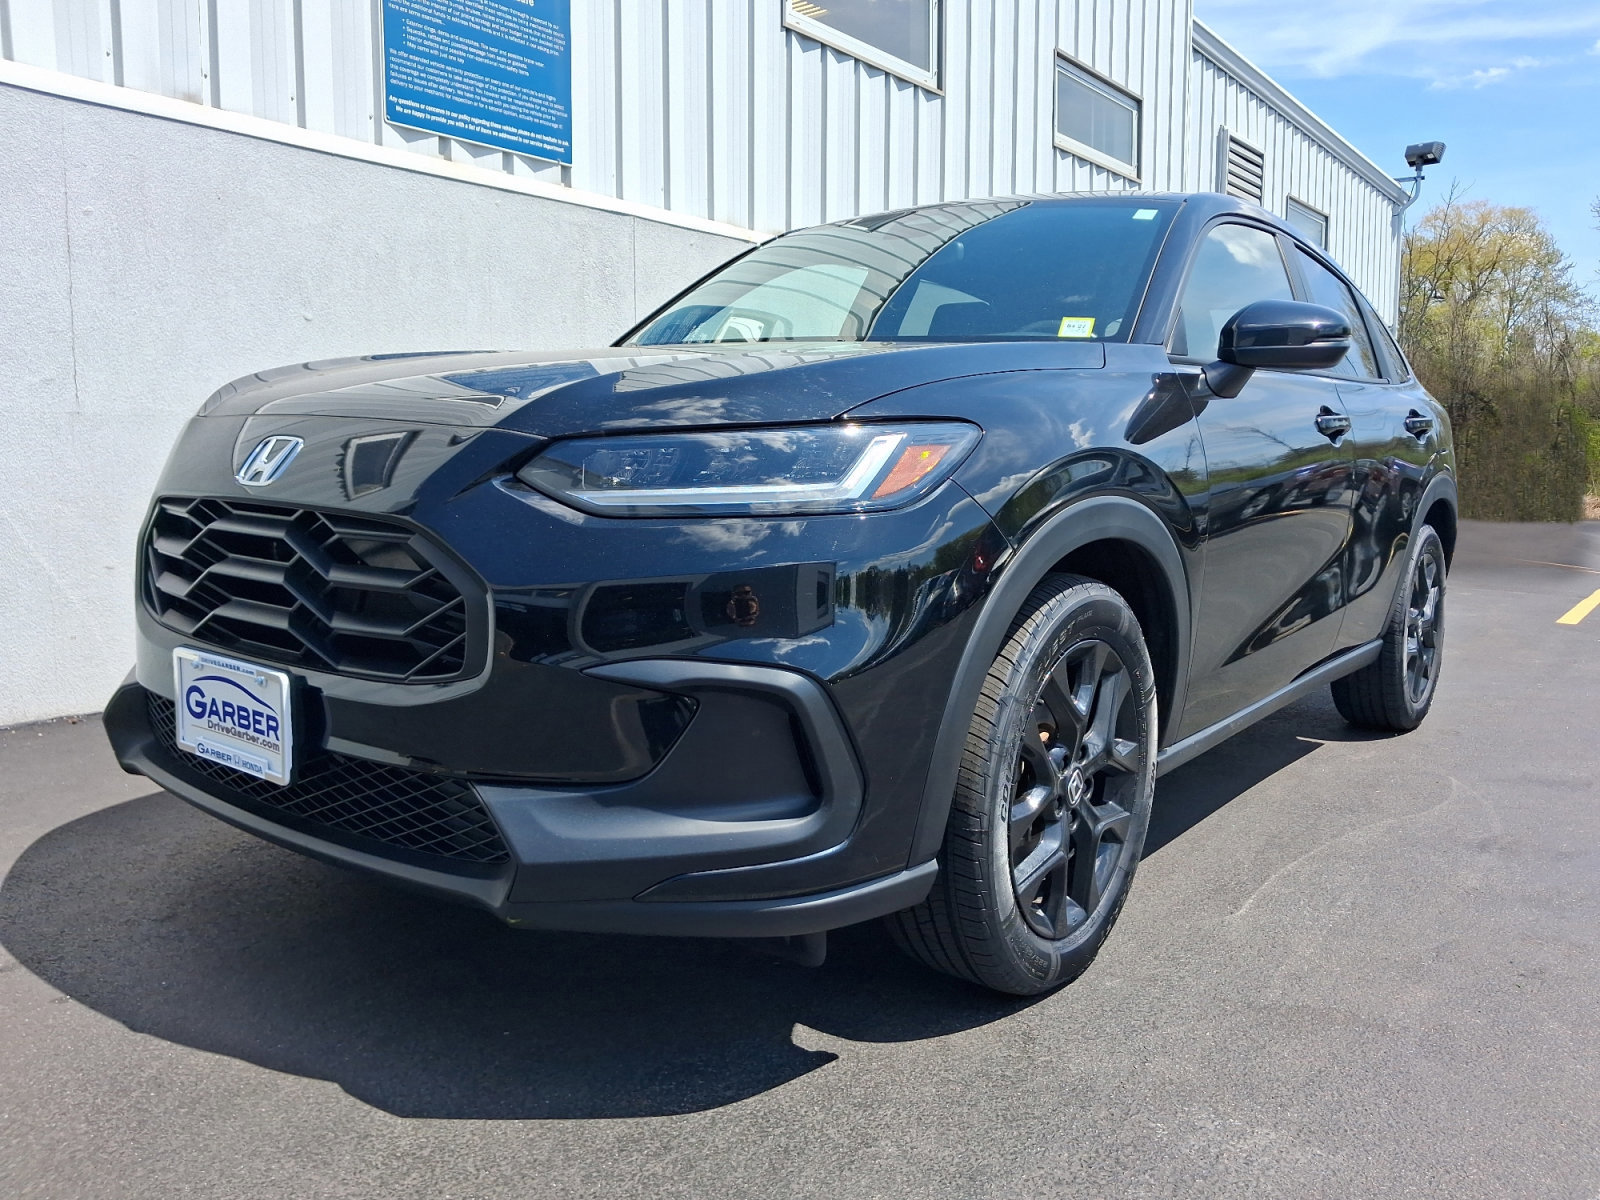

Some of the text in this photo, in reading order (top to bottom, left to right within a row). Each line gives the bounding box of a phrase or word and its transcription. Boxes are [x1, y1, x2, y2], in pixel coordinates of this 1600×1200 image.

[186, 685, 280, 741] GARBER
[208, 720, 280, 752] DriveGarber.com
[197, 743, 263, 774] GARBER HONDA
